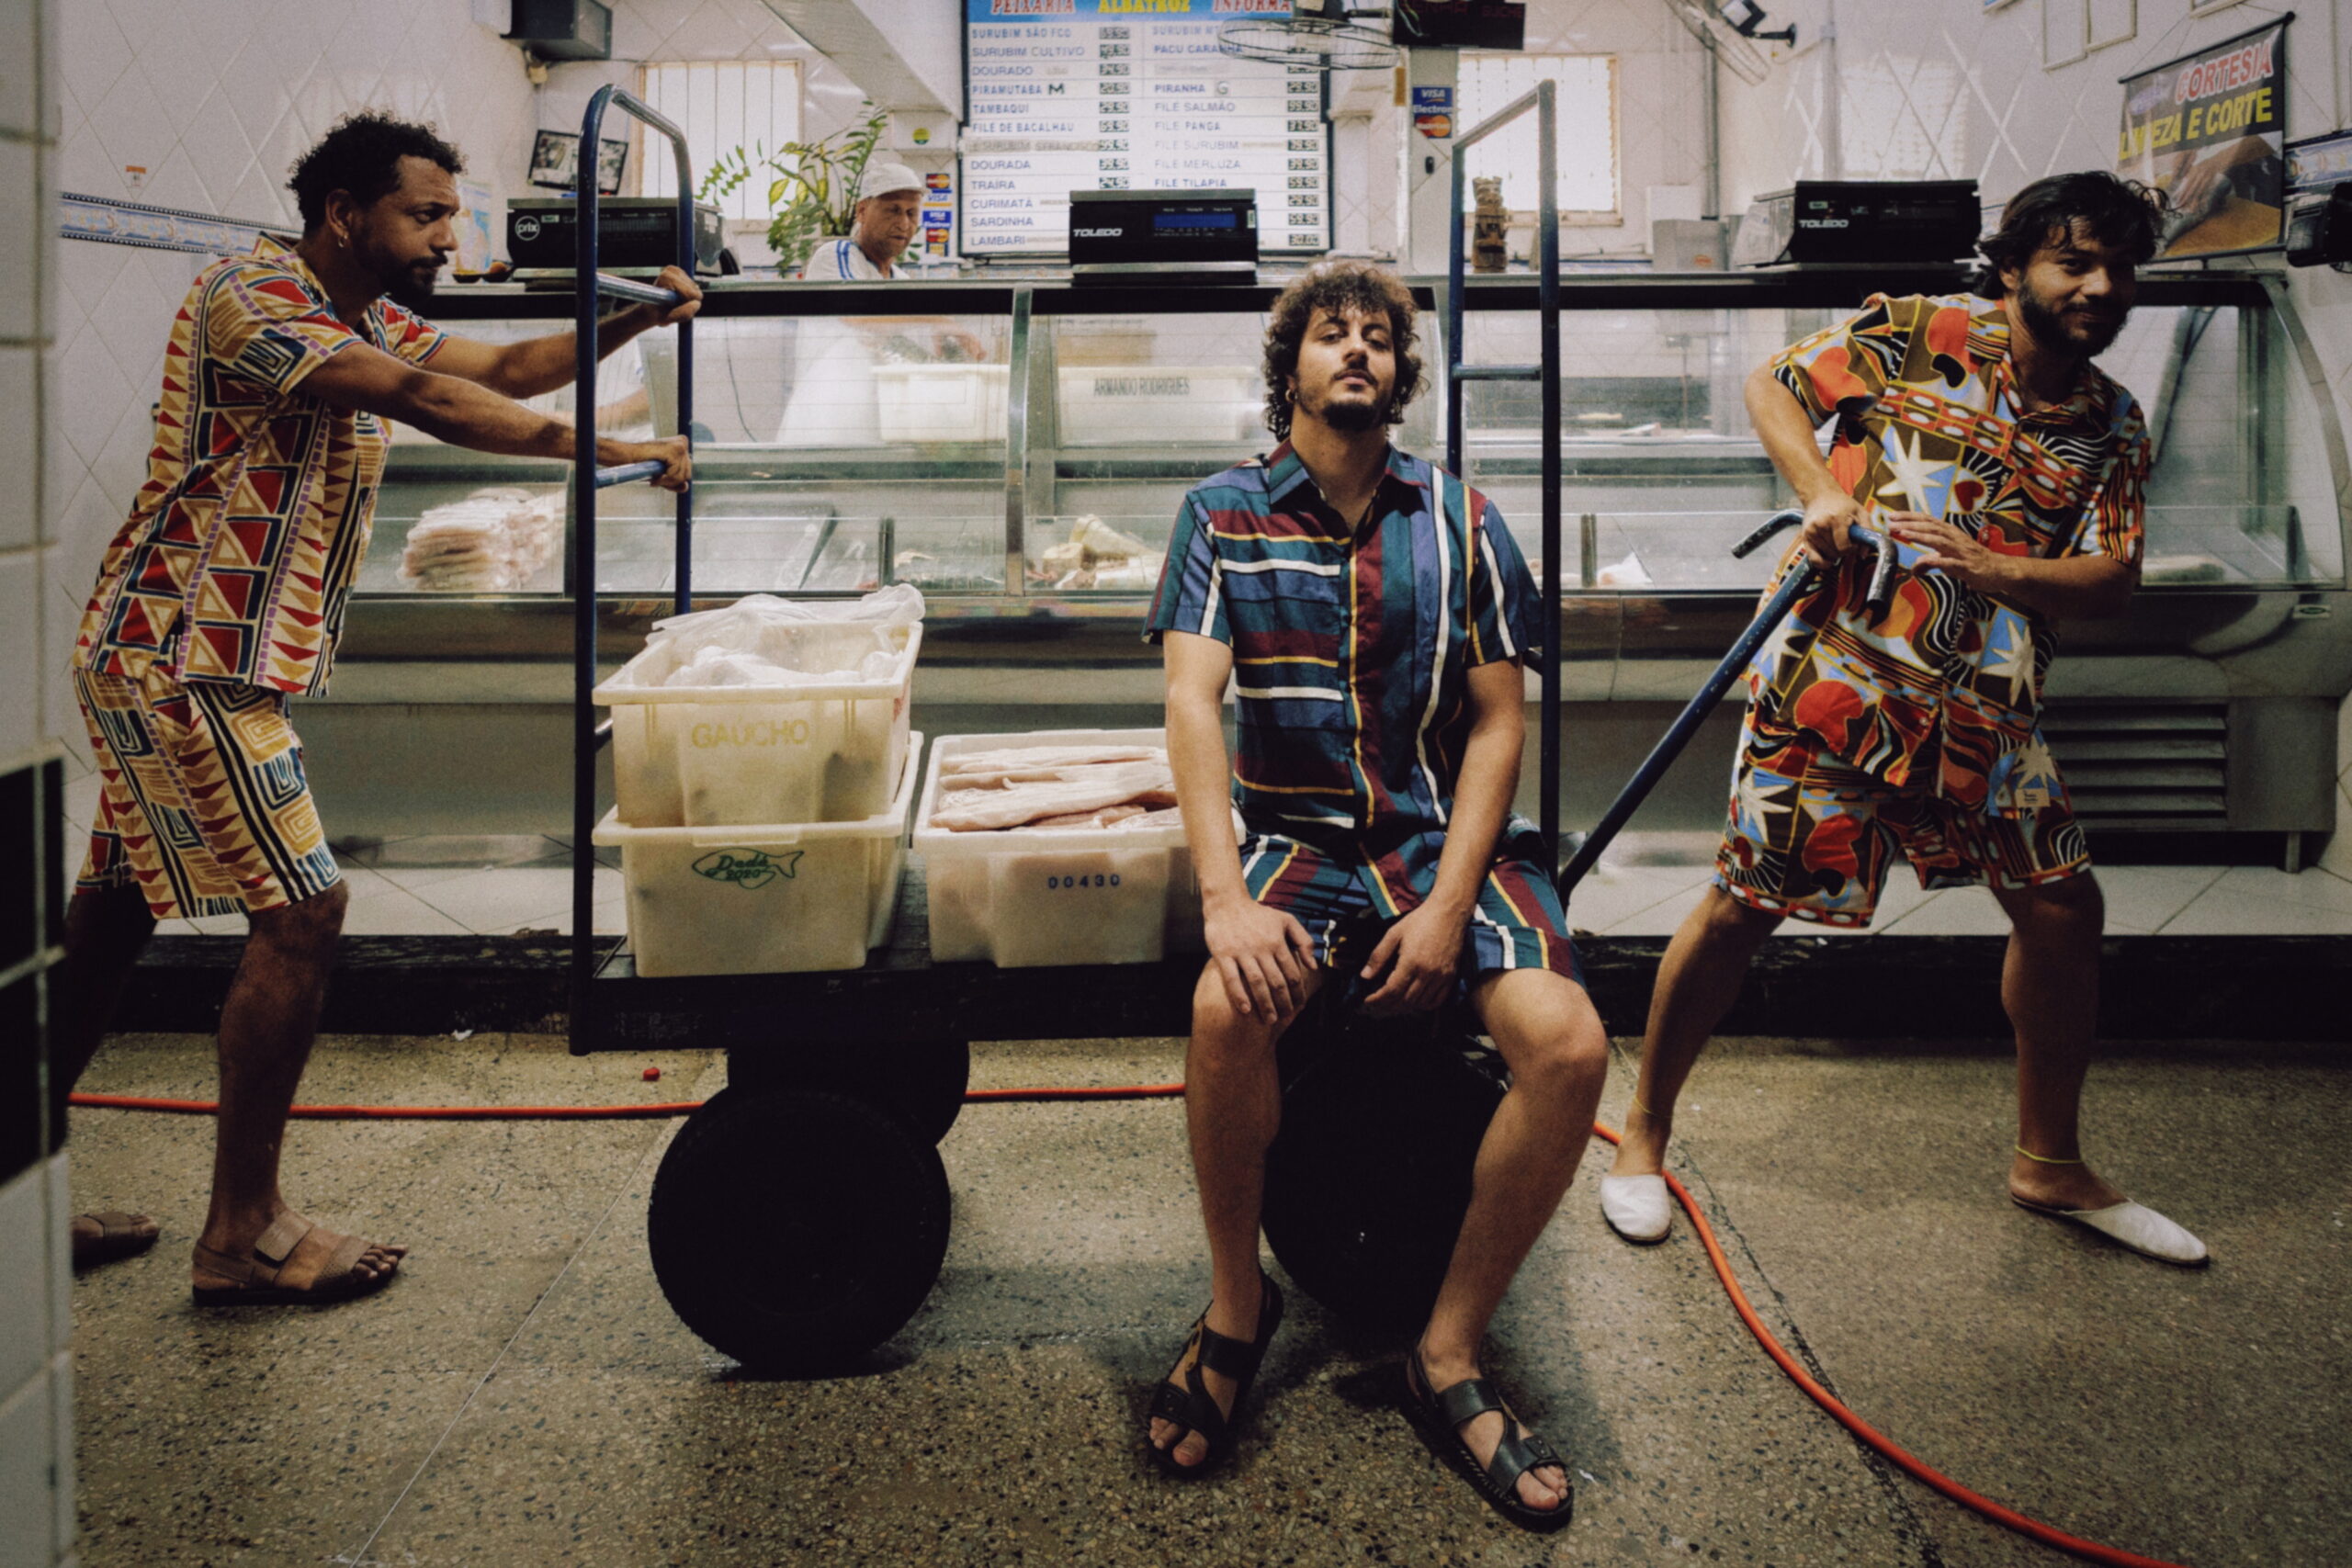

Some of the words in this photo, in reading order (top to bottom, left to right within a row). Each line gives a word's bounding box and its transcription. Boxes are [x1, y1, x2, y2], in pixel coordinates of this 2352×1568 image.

[991, 0, 1075, 14] PEIXARIA
[972, 28, 1021, 39] SURUBIM
[972, 47, 1027, 57] SURUBIM
[1031, 46, 1085, 57] CULTIVO
[1154, 45, 1183, 54] PACU
[972, 66, 1034, 76] DOURADO
[2176, 40, 2274, 105] CORTESIA
[972, 85, 1043, 95] PIRAMUTABA
[1048, 83, 1065, 95] M
[1154, 84, 1205, 94] PIRANHA
[1421, 89, 1445, 97] VISA
[973, 104, 1029, 114] TAMBAQUI
[1184, 100, 1236, 112] SALMÃO
[2187, 107, 2203, 140] E
[2207, 87, 2272, 136] CORTE
[1017, 122, 1074, 132] BACALHAU
[1185, 121, 1221, 130] PANGA
[1184, 141, 1239, 150] SURUBIM
[970, 160, 1031, 171] DOURADA
[1184, 160, 1240, 169] MERLUZA
[1183, 178, 1227, 187] TILAPIA
[517, 220, 539, 233] prix
[971, 217, 1034, 228] SARDINHA
[1799, 220, 1849, 228] TOLEDO
[1073, 228, 1123, 237] TOLEDO
[971, 235, 1025, 246] LAMBARI
[1094, 377, 1137, 396] ARMANDO
[1139, 376, 1191, 396] RODRIGUES
